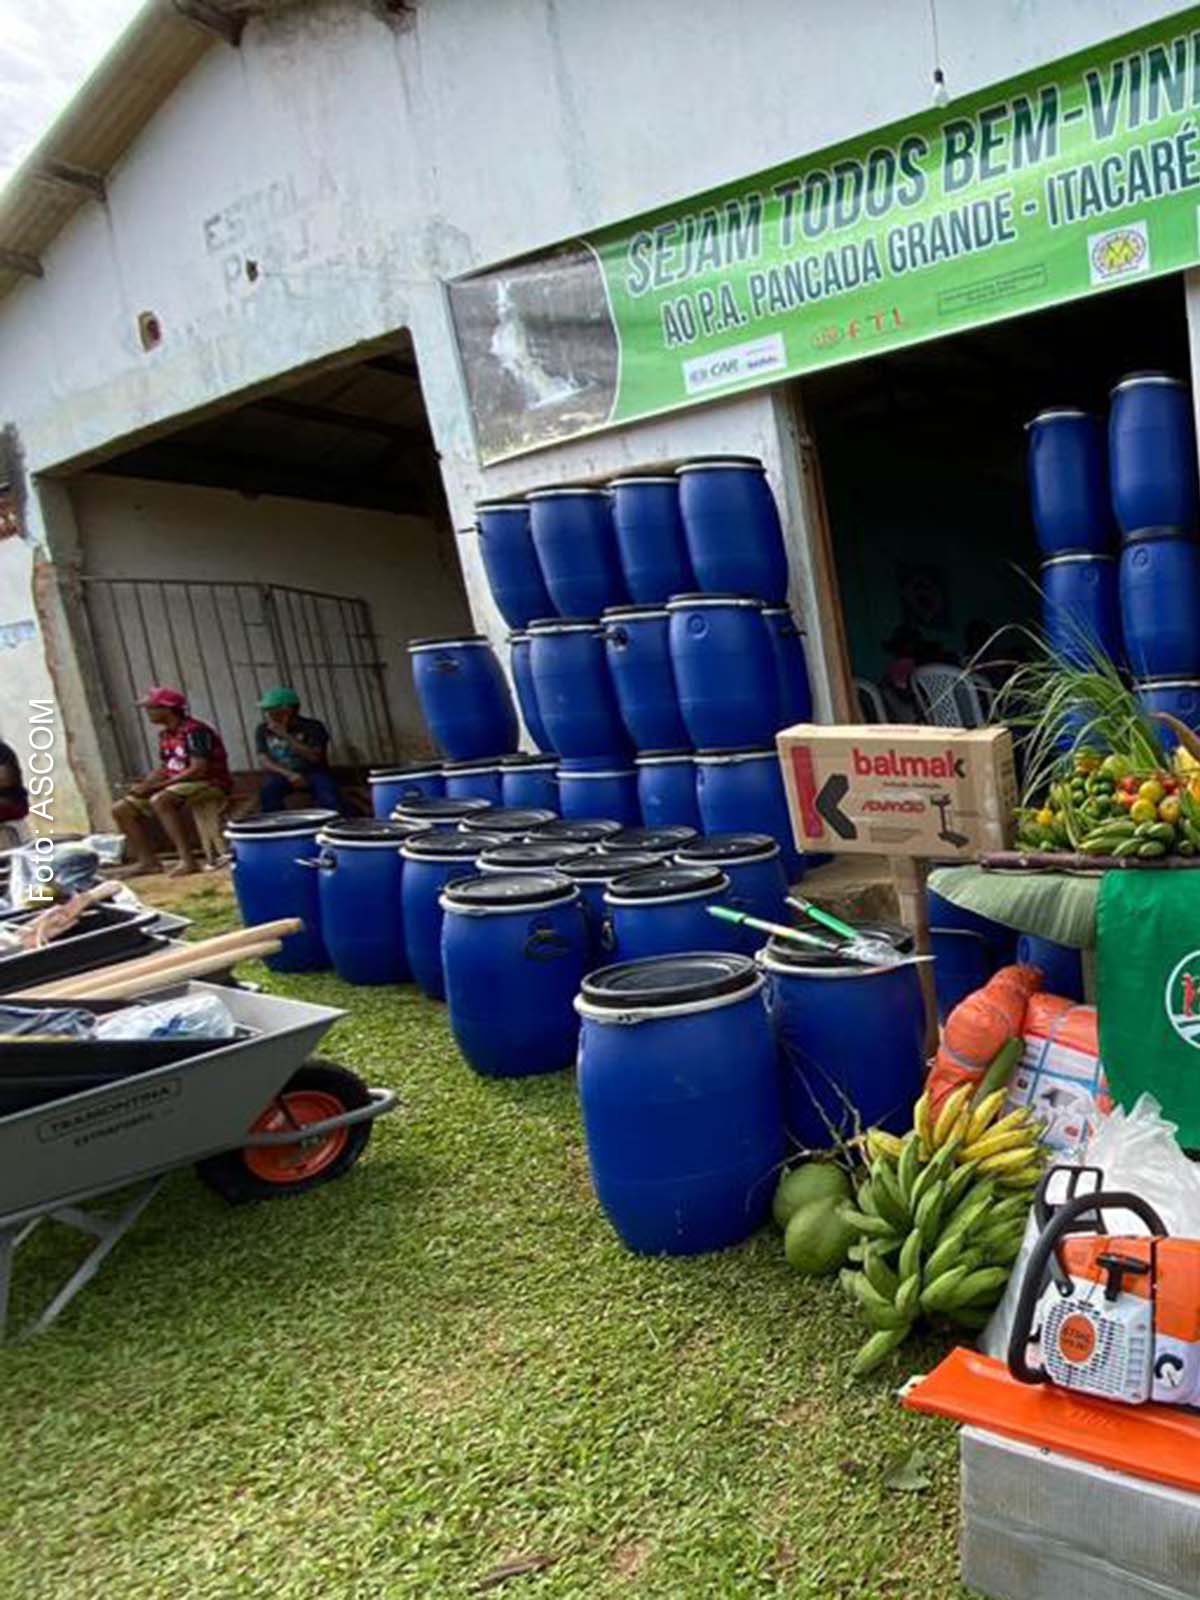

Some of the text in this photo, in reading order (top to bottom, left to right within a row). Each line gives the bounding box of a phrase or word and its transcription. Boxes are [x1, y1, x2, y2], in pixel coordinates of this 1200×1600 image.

[626, 194, 764, 295] SEJAM
[772, 136, 929, 248] TODOS
[660, 295, 698, 347] AO
[701, 281, 747, 336] P.A.
[749, 237, 882, 318] PANCADA
[886, 191, 1015, 276] GRANDE
[851, 747, 967, 779] balmak
